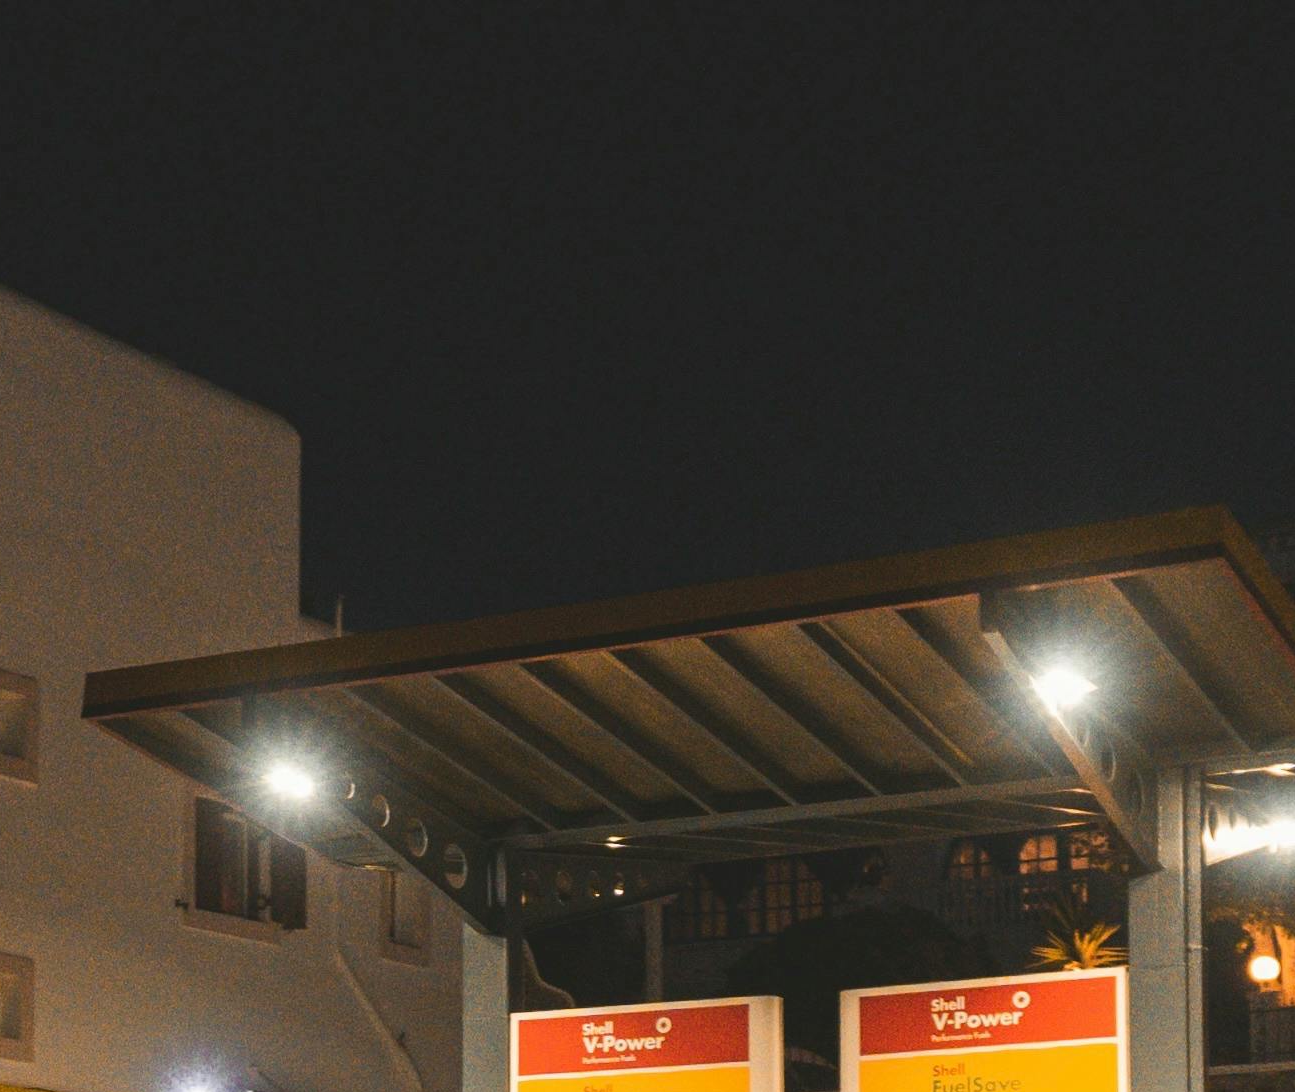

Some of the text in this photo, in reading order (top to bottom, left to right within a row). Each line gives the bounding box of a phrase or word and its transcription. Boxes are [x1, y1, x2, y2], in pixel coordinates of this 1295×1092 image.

[932, 997, 965, 1012] Shell
[582, 1021, 614, 1035] Shell
[932, 1011, 1023, 1031] V-Power
[583, 1036, 665, 1053] V-Power
[932, 1065, 966, 1078] Shell
